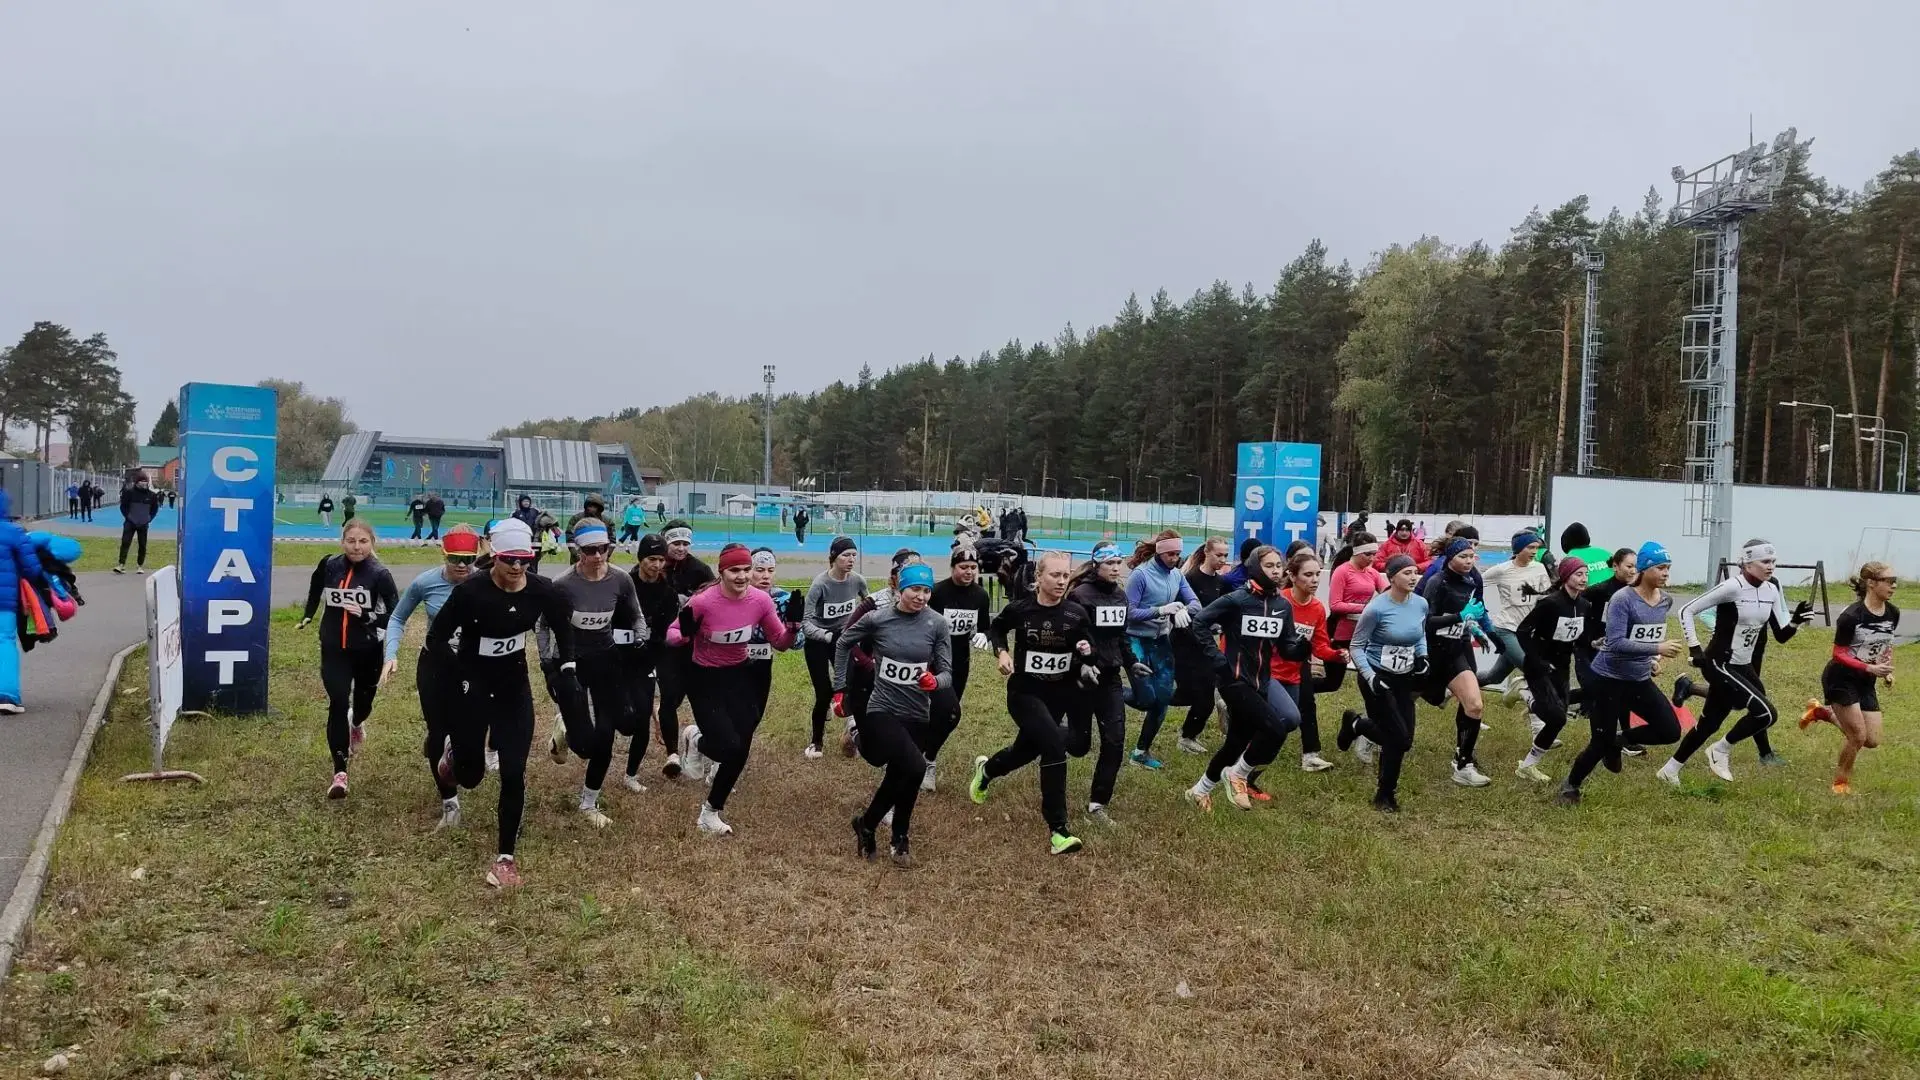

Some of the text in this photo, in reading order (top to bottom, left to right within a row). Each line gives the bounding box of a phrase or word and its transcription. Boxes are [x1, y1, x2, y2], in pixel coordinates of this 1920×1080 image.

[204, 445, 260, 685] СТАРТ
[330, 591, 367, 605] 850
[828, 602, 853, 616] 848
[1101, 609, 1125, 623] 119
[951, 619, 973, 633] 195
[1246, 619, 1279, 635] 843
[1566, 626, 1578, 639] 73
[1634, 626, 1663, 640] 845
[723, 630, 744, 642] 17
[493, 638, 516, 655] 20
[748, 648, 768, 656] 548
[1030, 655, 1068, 671] 846
[885, 663, 921, 681] 802
